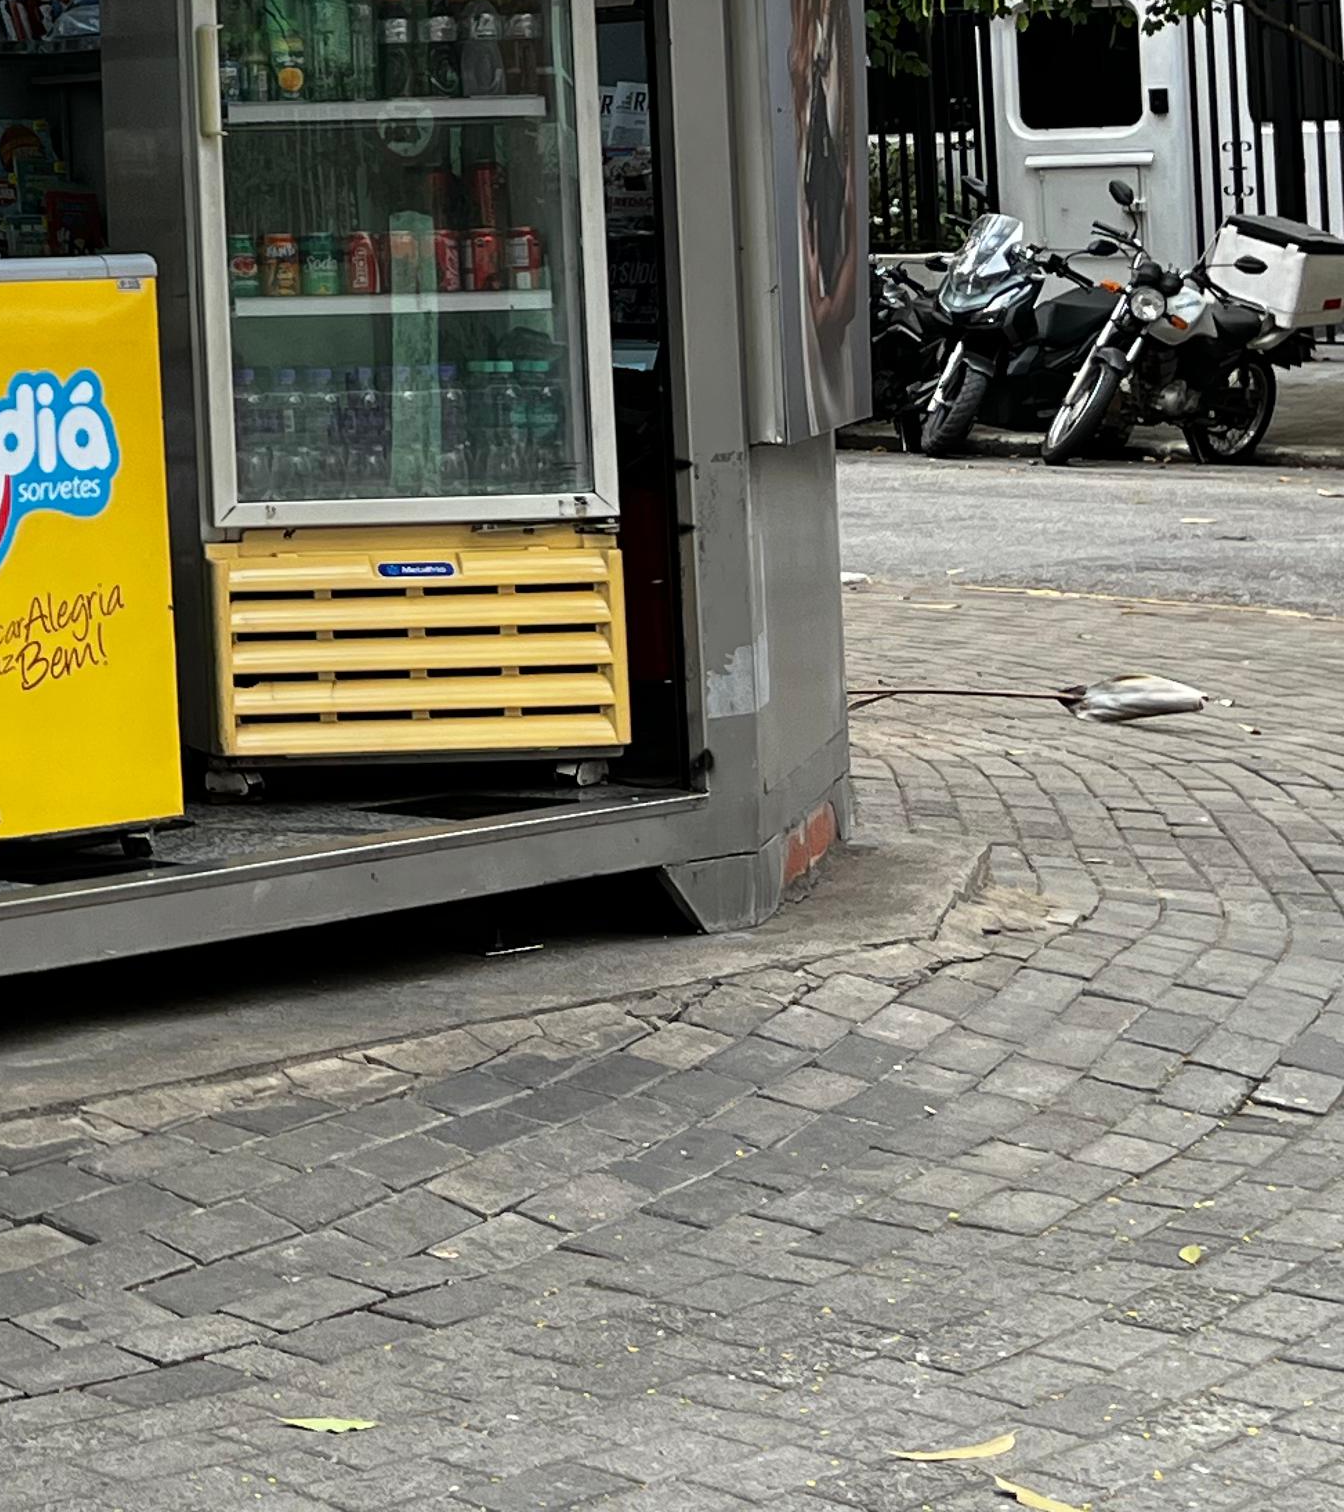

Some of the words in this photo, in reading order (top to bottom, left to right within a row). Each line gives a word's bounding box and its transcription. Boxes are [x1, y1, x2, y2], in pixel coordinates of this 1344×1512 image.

[18, 476, 102, 504] sorvetes
[23, 584, 127, 647] Alegria
[18, 632, 109, 691] Bem!
